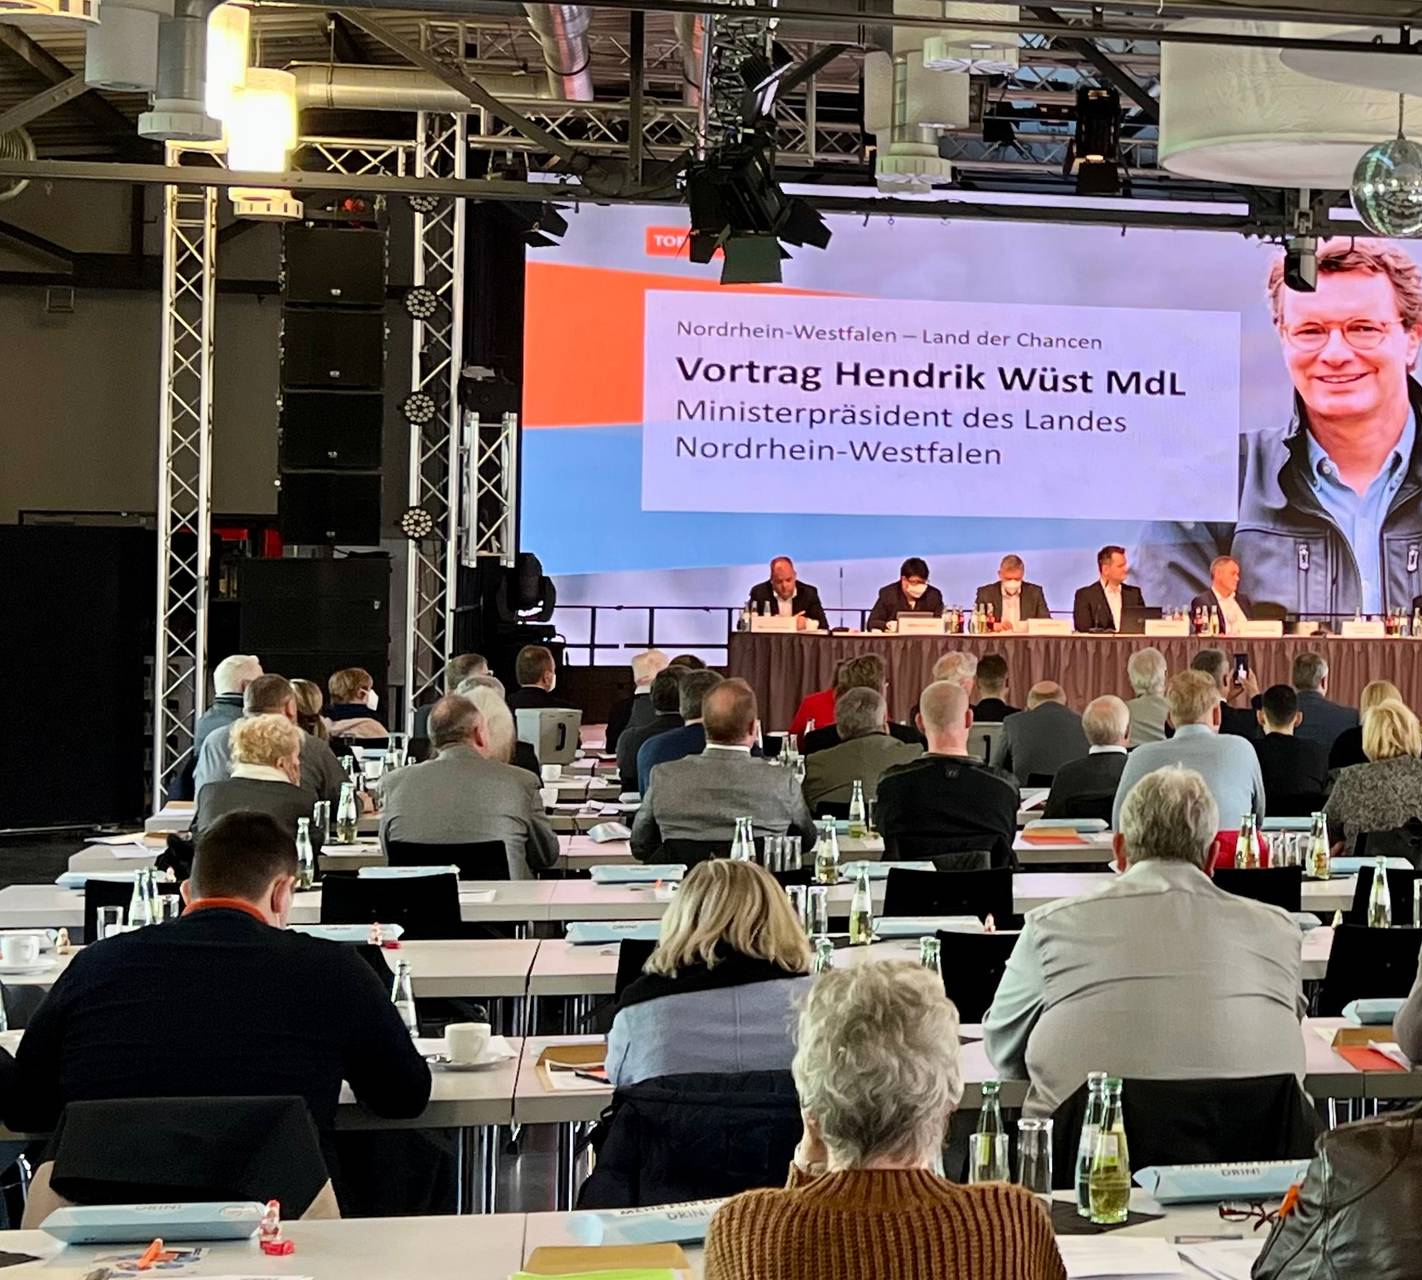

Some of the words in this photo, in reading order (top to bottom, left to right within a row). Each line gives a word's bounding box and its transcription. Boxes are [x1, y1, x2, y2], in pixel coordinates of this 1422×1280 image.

[677, 321, 896, 343] Nordrhein-Westfalen
[923, 329, 970, 345] Land
[976, 331, 1011, 347] der
[1016, 332, 1102, 350] Chancen
[676, 357, 822, 393] Vortrag
[836, 361, 986, 391] Hendrik
[997, 366, 1093, 393] Wüst
[1107, 370, 1187, 396] MdL
[677, 400, 952, 430] Ministerpräsident
[962, 406, 1014, 430] des
[1025, 409, 1127, 433] Landes
[677, 437, 1001, 465] Nordrhein-Westfalen
